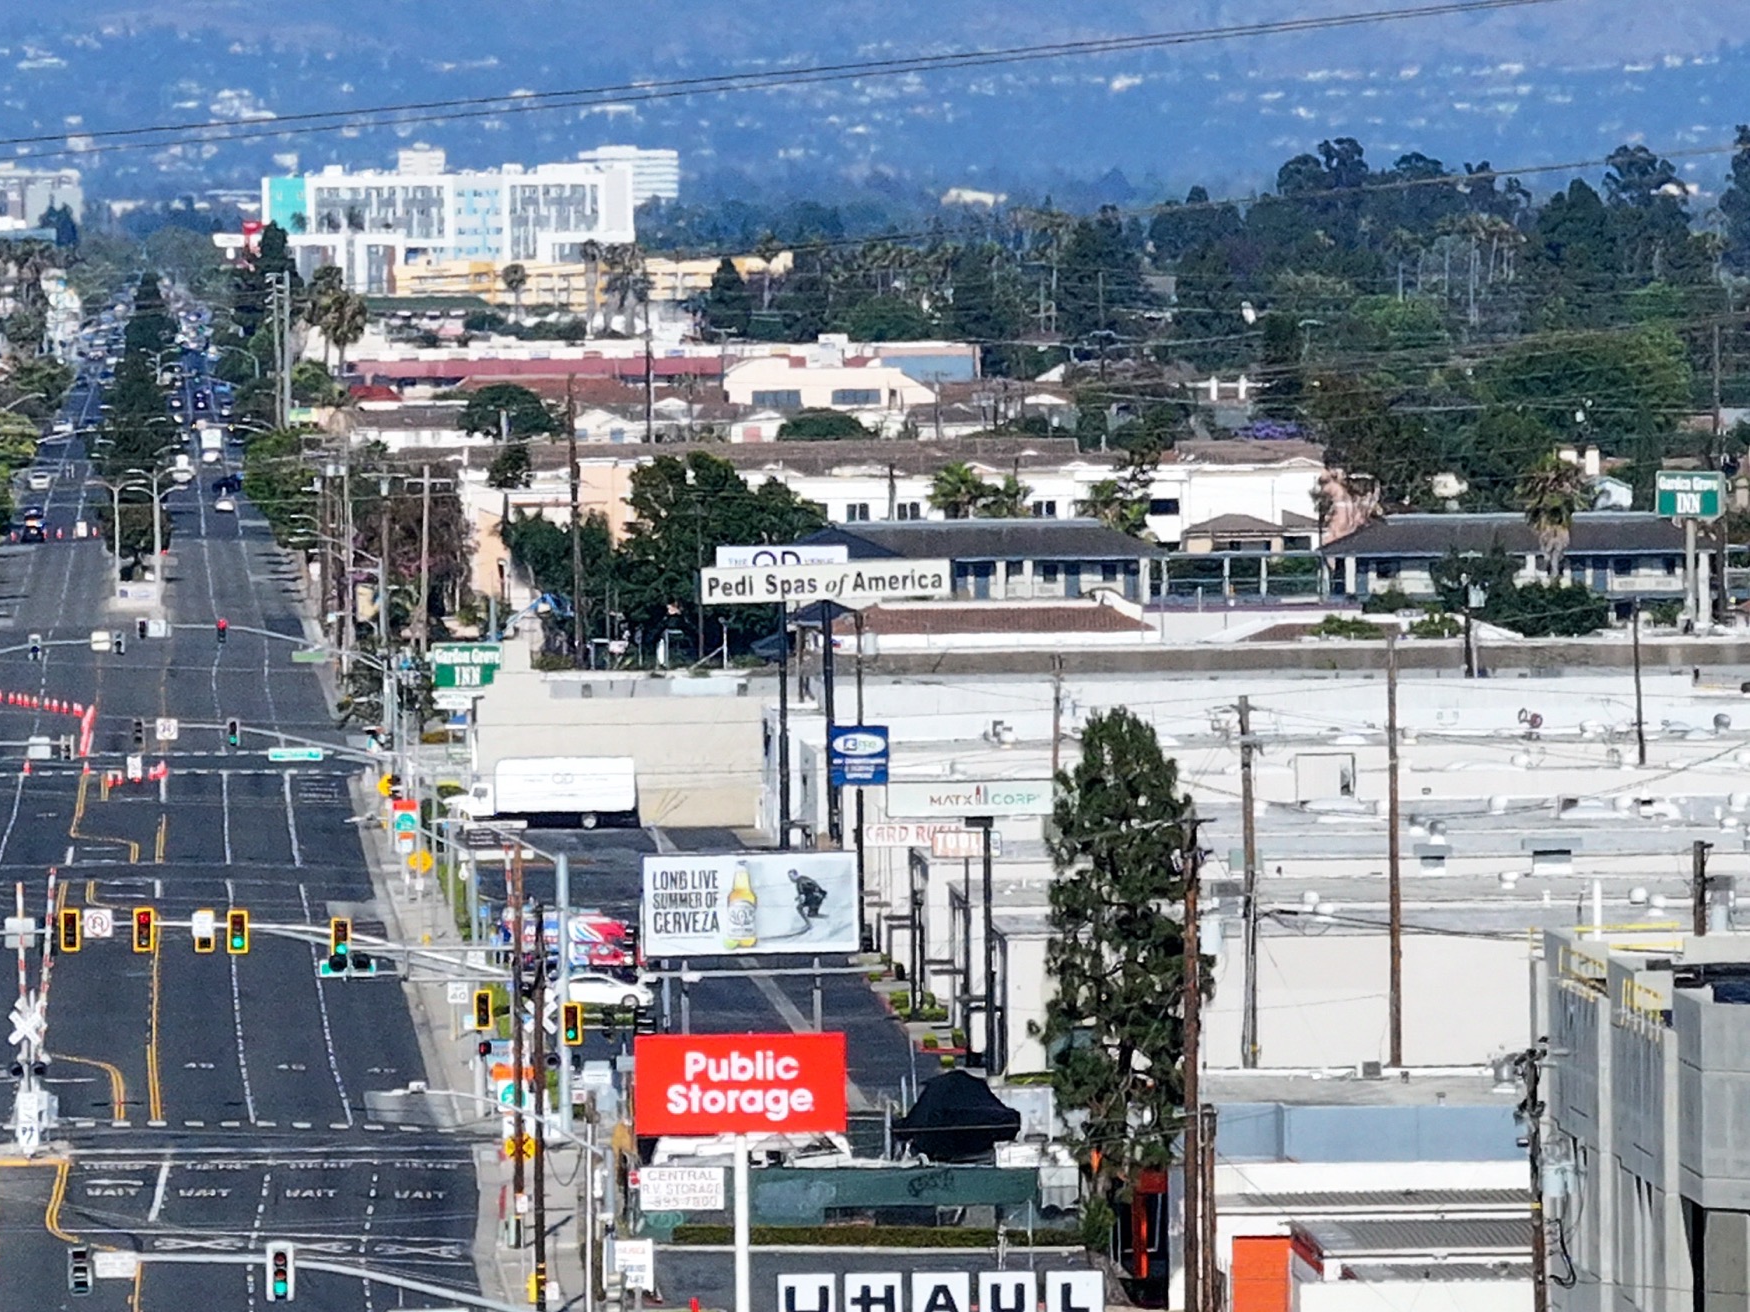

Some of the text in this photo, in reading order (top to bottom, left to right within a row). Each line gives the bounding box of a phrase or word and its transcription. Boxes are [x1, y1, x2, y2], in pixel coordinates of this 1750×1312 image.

[708, 569, 943, 600] Pedi Spas of America
[455, 666, 481, 686] INN
[991, 793, 1038, 806] CORP
[866, 825, 909, 843] CARD
[652, 869, 719, 891] LONG LIVE
[652, 891, 719, 910] SUMMER OF
[653, 911, 720, 934] CERVEZA
[684, 1050, 800, 1082] Public
[666, 1083, 814, 1121] Storage
[647, 1170, 718, 1182] CENTRAL
[668, 1183, 722, 1195] STORAGE
